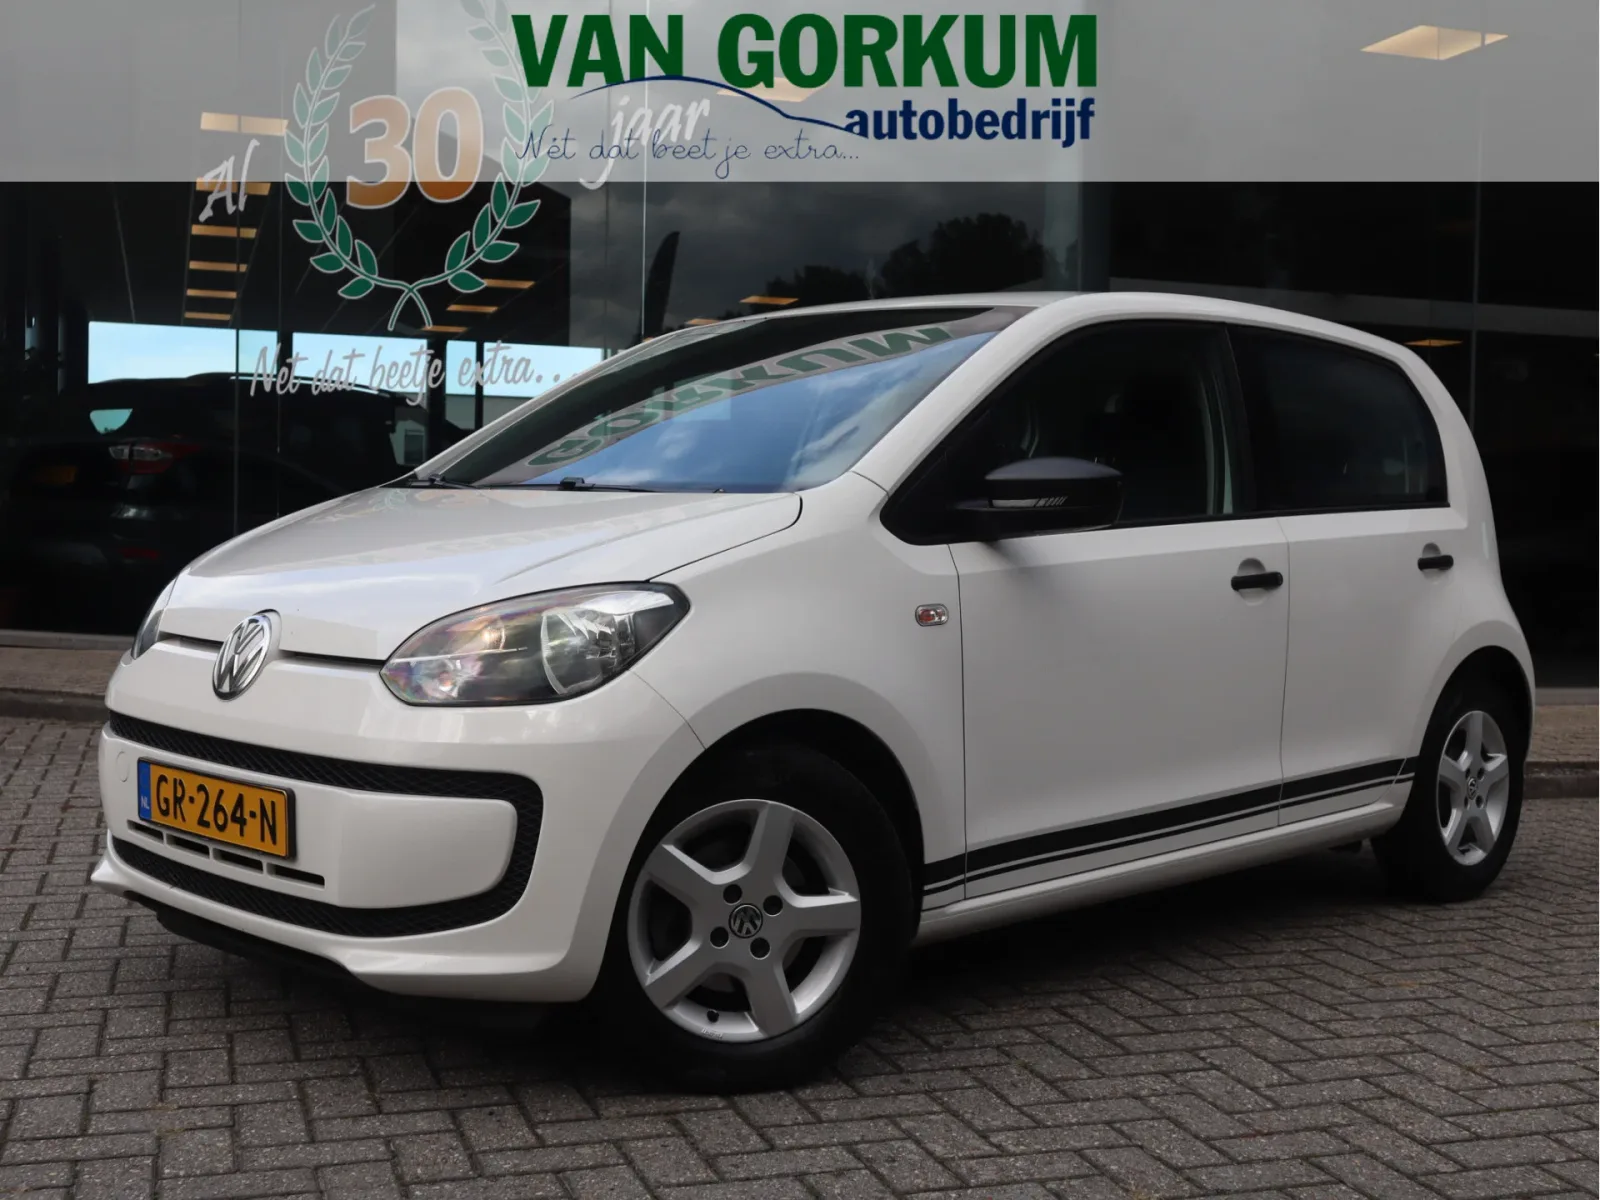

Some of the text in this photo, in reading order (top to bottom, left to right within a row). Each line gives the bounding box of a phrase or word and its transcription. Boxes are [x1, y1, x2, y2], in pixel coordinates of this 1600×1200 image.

[346, 86, 484, 209] 30
[579, 94, 711, 190] jaar
[311, 348, 365, 395] dat
[368, 345, 447, 406] beetje
[155, 773, 278, 846] GR-264-N
